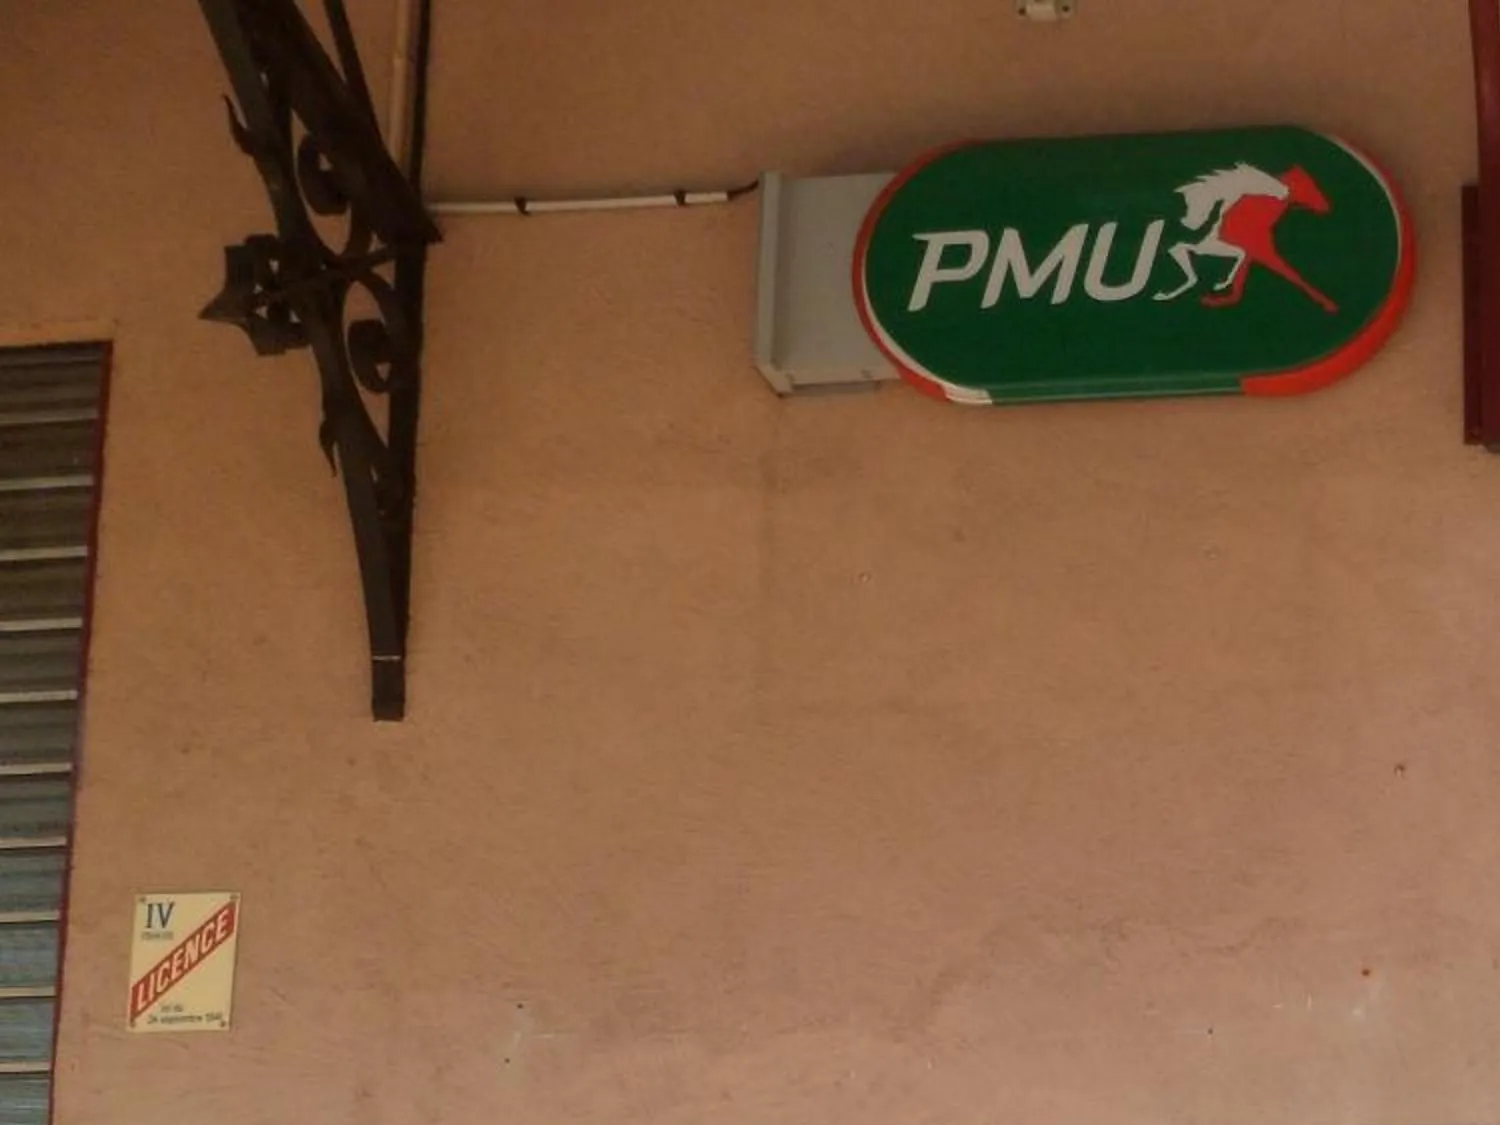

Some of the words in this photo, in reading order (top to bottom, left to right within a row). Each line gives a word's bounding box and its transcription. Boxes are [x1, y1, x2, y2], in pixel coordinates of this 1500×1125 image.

[907, 219, 1166, 312] PMU
[137, 908, 230, 1012] LICENCE
[145, 901, 175, 929] IV
